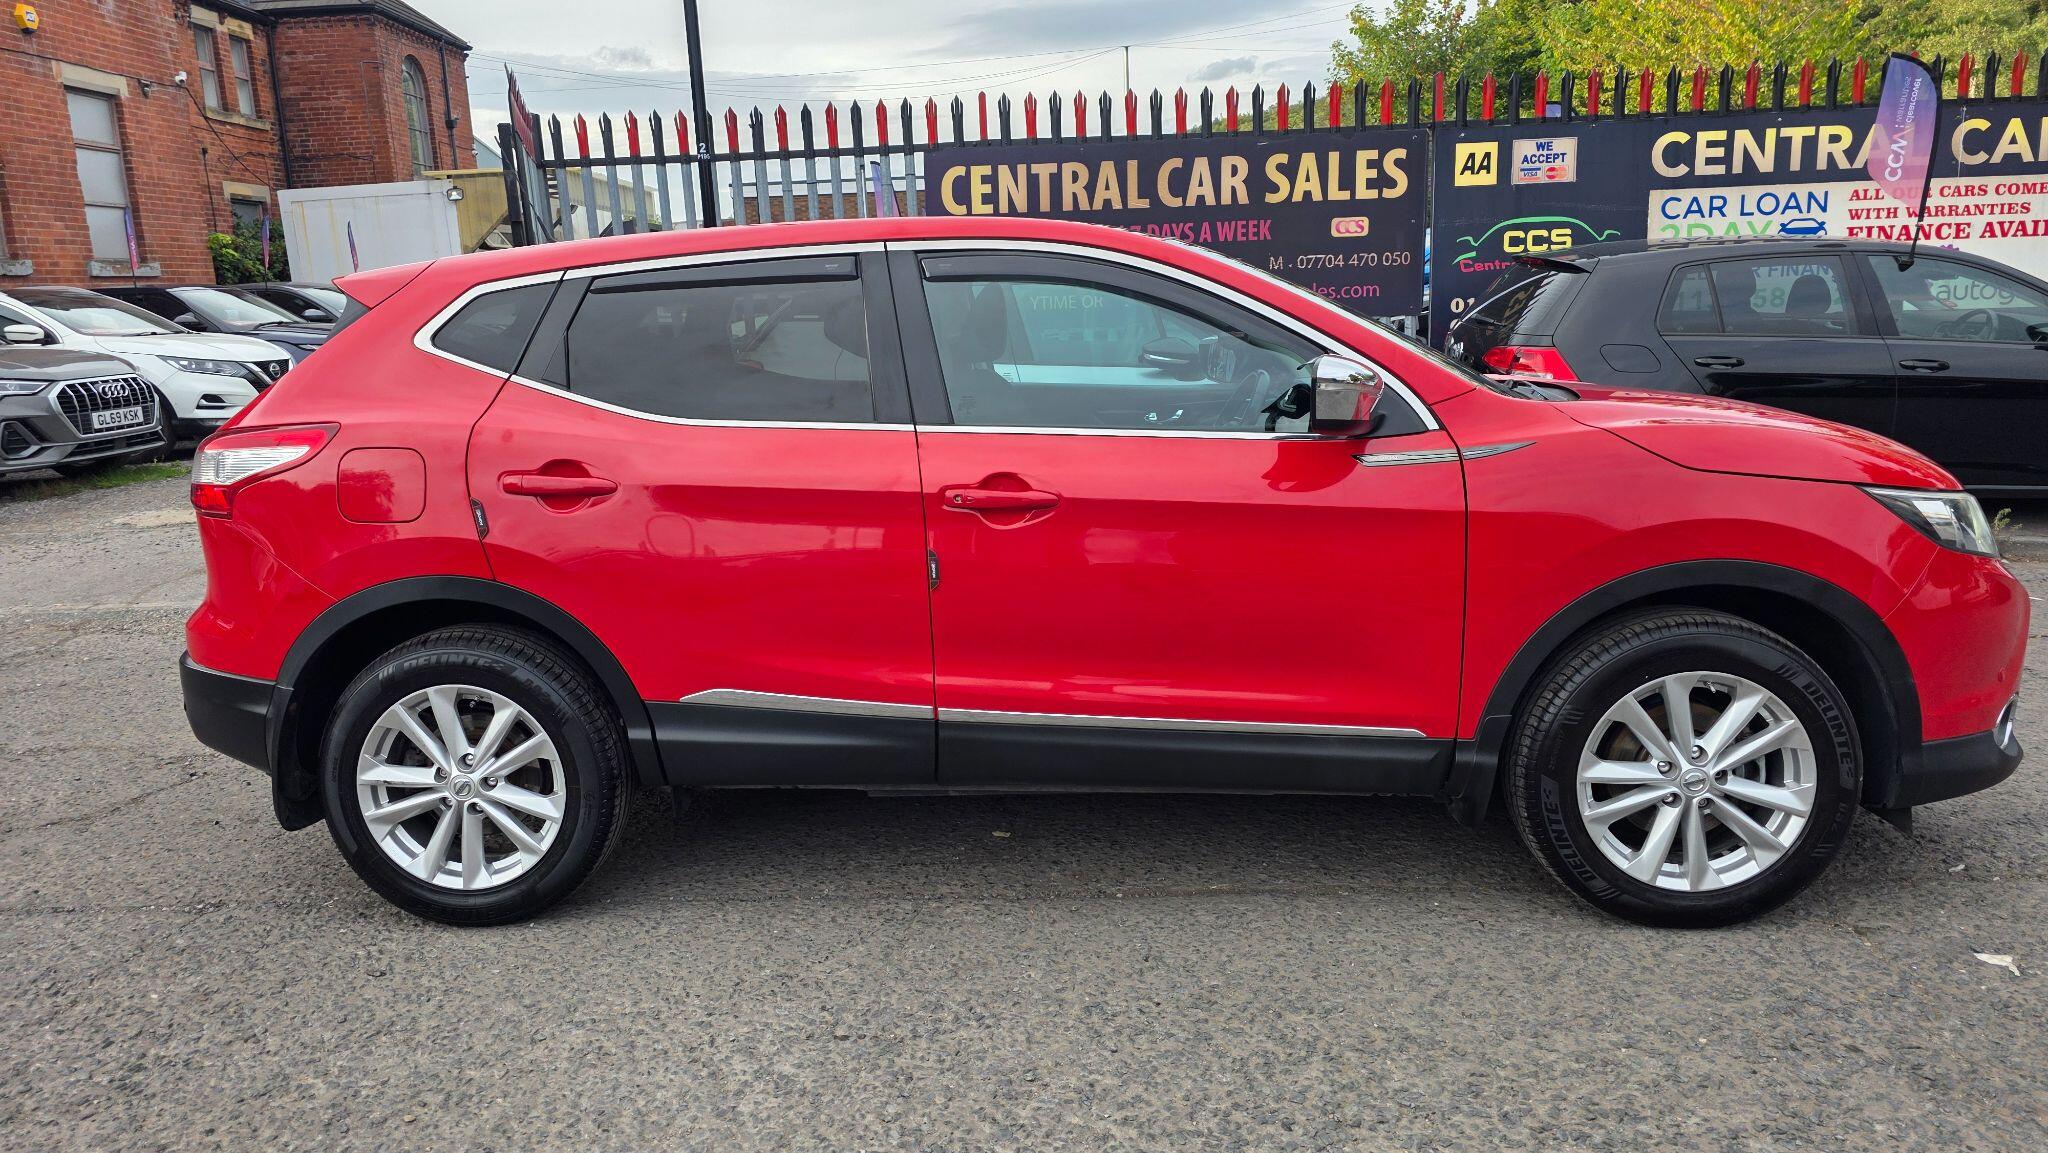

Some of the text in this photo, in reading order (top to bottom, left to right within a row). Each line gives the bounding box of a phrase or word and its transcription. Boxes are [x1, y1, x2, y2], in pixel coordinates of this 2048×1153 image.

[698, 142, 707, 153] 2
[1536, 141, 1553, 152] WE
[1951, 116, 2048, 166] CA
[1460, 151, 1492, 176] AA
[1521, 152, 1567, 165] ACCEPT
[940, 147, 1410, 216] CENTRAL CAR SALES
[1849, 188, 1885, 202] ALL
[1938, 183, 1989, 198] CARS
[1994, 181, 2048, 196] COME
[1660, 190, 1829, 220] CAR LOAN
[1848, 202, 2031, 221] WITH WARRANTIES
[1147, 222, 1195, 244] DAYS
[1199, 221, 1212, 243] A
[1216, 219, 1272, 242] WEEK
[1334, 219, 1366, 235] CCS
[1846, 219, 2048, 241] FINANCE AVAI
[1503, 228, 1573, 253] CCS
[1297, 254, 1345, 269] 07704
[1348, 252, 1378, 268] 470
[1382, 251, 1411, 267] 050
[1460, 260, 1516, 273] Centr
[97, 409, 140, 426] GL69 KSK
[1801, 681, 1854, 768] DELINTE
[1543, 802, 1598, 882] DELINTE
